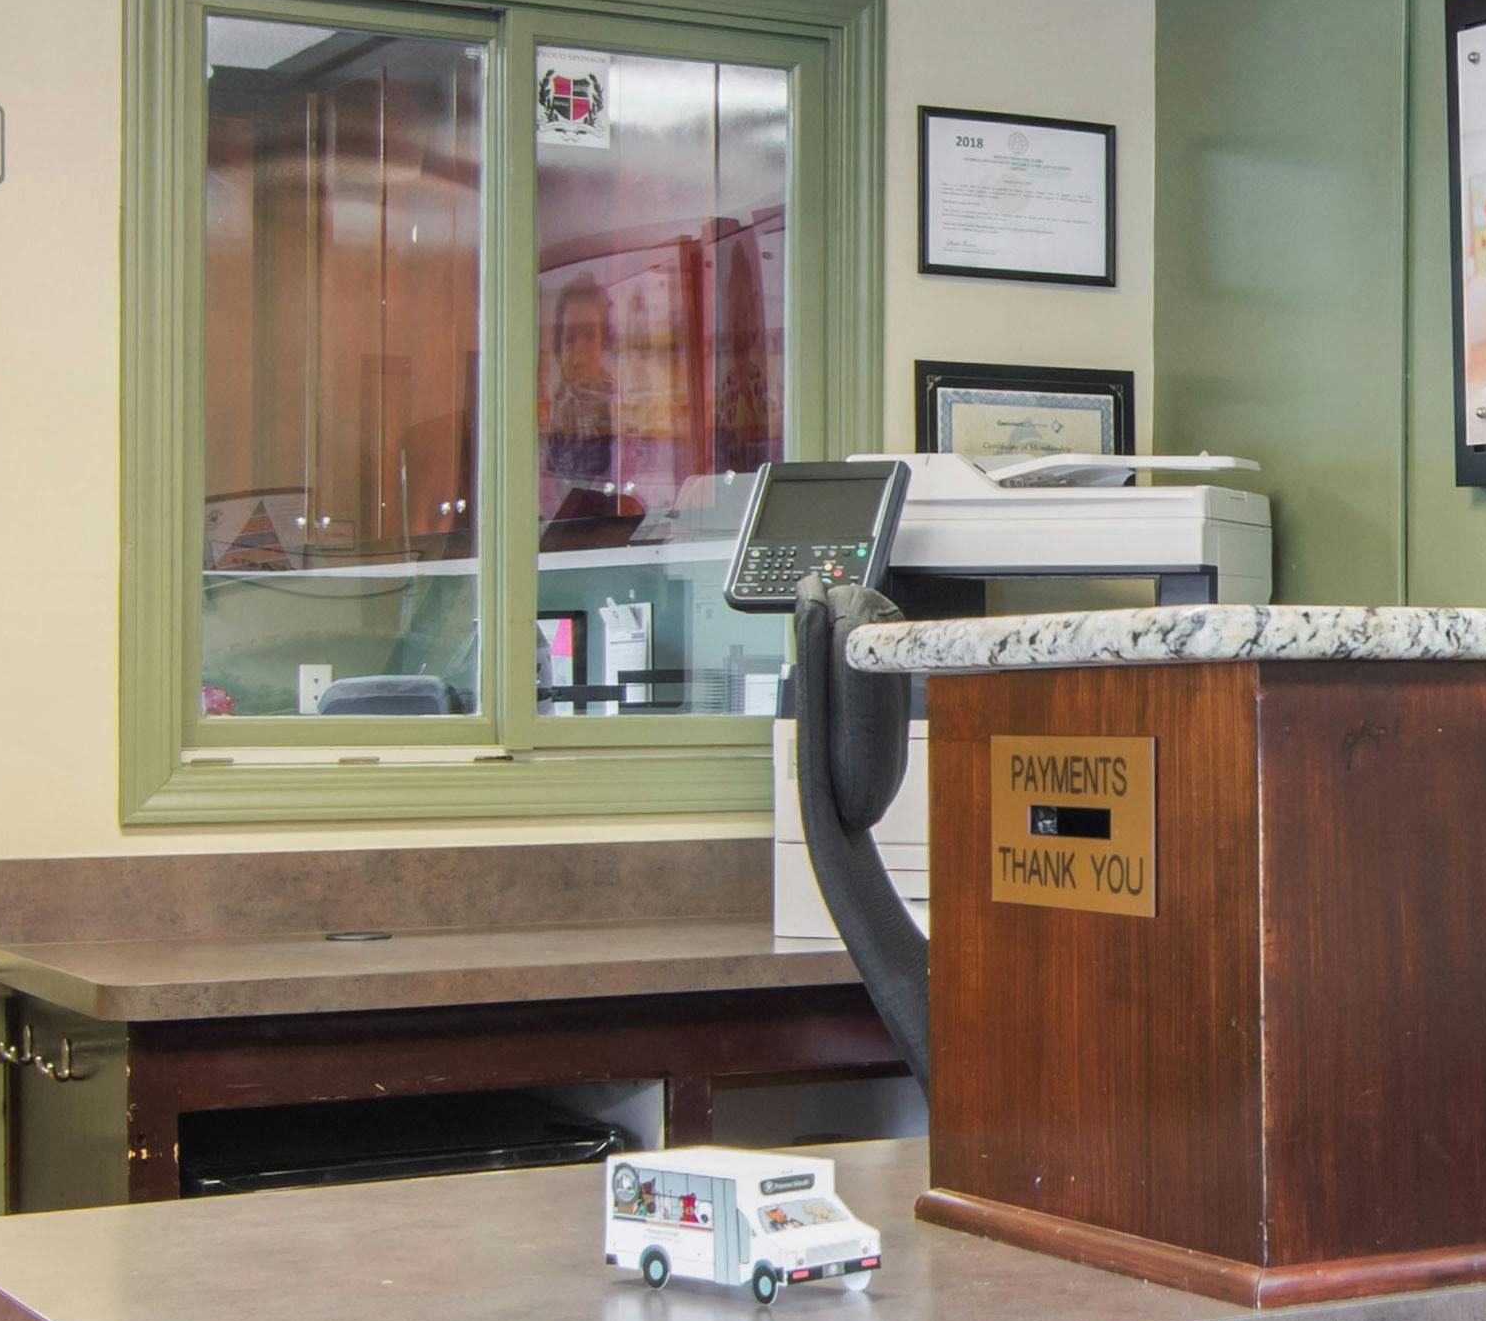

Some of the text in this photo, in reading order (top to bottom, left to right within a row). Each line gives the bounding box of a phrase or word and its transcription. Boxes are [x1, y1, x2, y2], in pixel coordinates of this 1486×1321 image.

[955, 135, 984, 150] 2018
[1011, 754, 1127, 797] PAYMENTS
[998, 846, 1143, 896] THANK YOU
